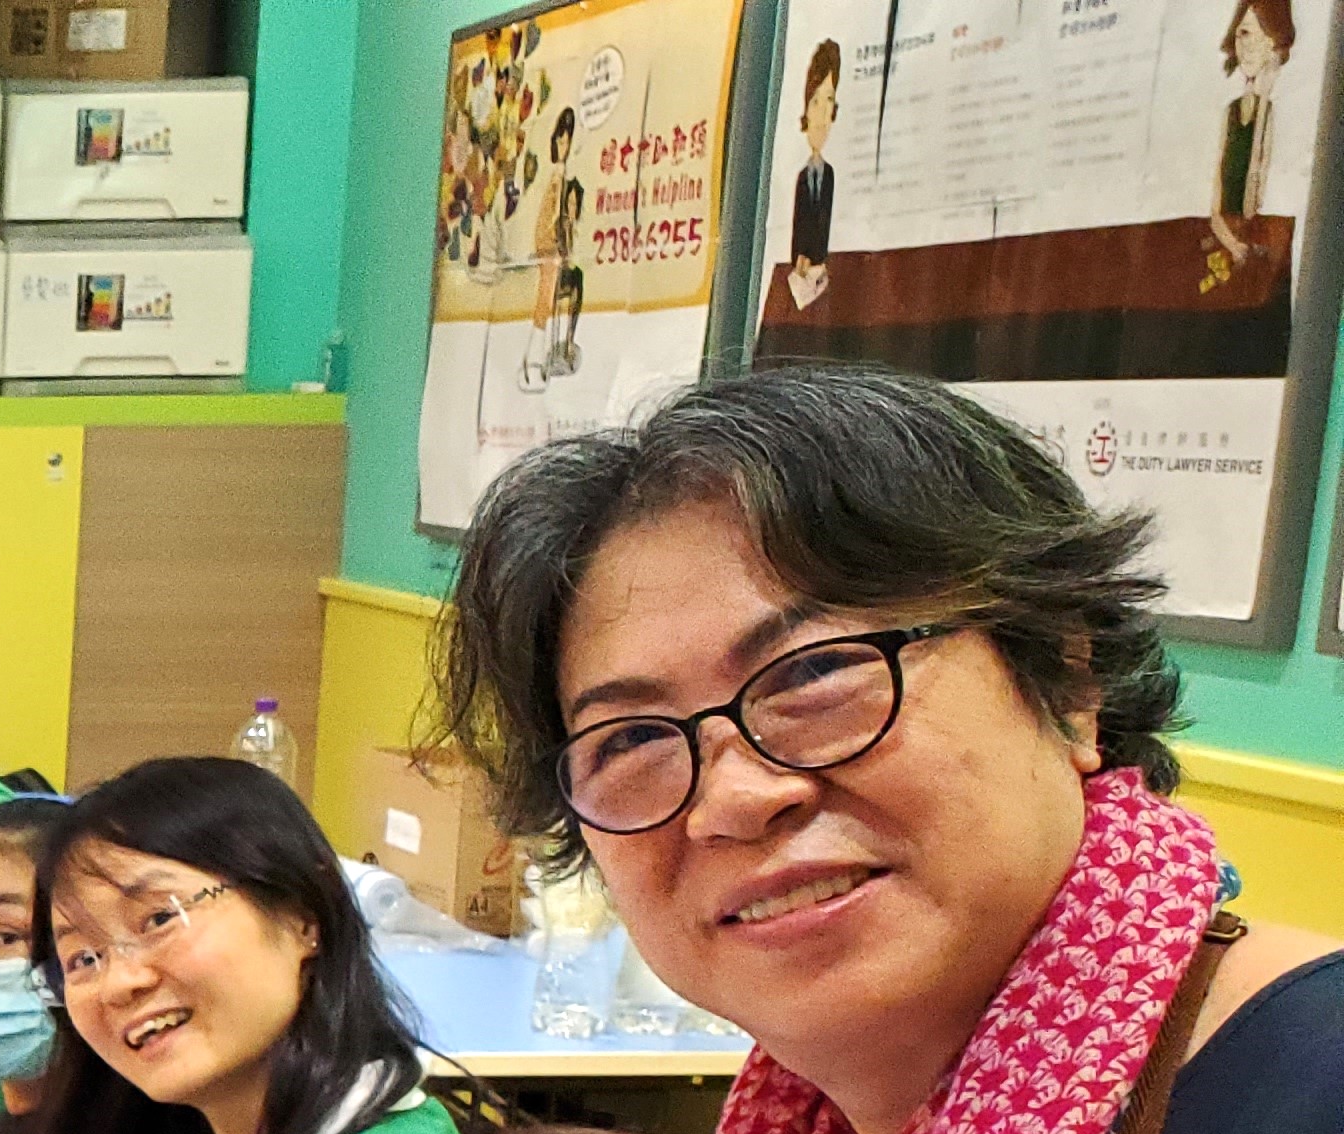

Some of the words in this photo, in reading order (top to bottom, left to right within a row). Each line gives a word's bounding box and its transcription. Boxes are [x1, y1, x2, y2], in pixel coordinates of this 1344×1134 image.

[652, 173, 703, 209] Helpline
[593, 217, 703, 264] 23866255
[1122, 456, 1136, 470] THE
[1139, 456, 1163, 471] DUTY
[1167, 457, 1212, 473] LAWYER
[1214, 458, 1263, 475] SERVICE
